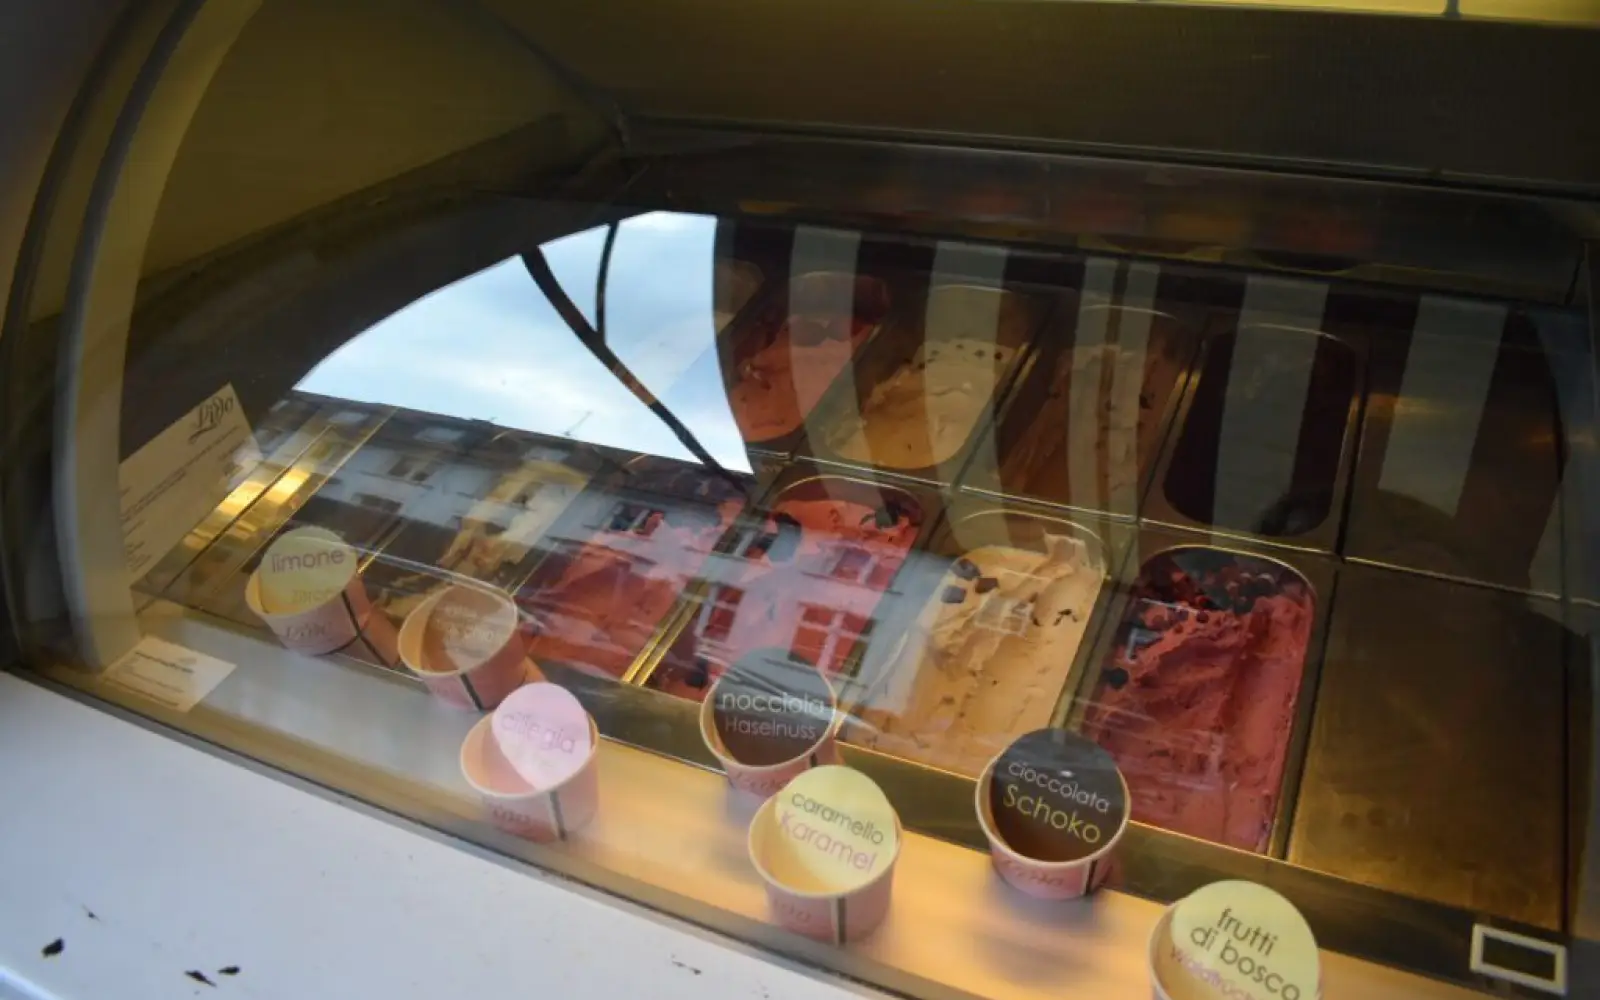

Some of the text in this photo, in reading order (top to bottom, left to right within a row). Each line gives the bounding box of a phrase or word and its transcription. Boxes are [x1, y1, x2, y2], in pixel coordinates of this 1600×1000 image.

[271, 548, 345, 573] limone
[721, 691, 825, 714] nocciola
[724, 716, 816, 740] Haselnuss
[1003, 784, 1101, 844] Schoko
[1008, 760, 1111, 814] cioccolata
[781, 810, 878, 874] Karamel
[790, 792, 885, 846] caramello
[1217, 907, 1279, 957] frutti
[1189, 926, 1301, 1000] di bosco
